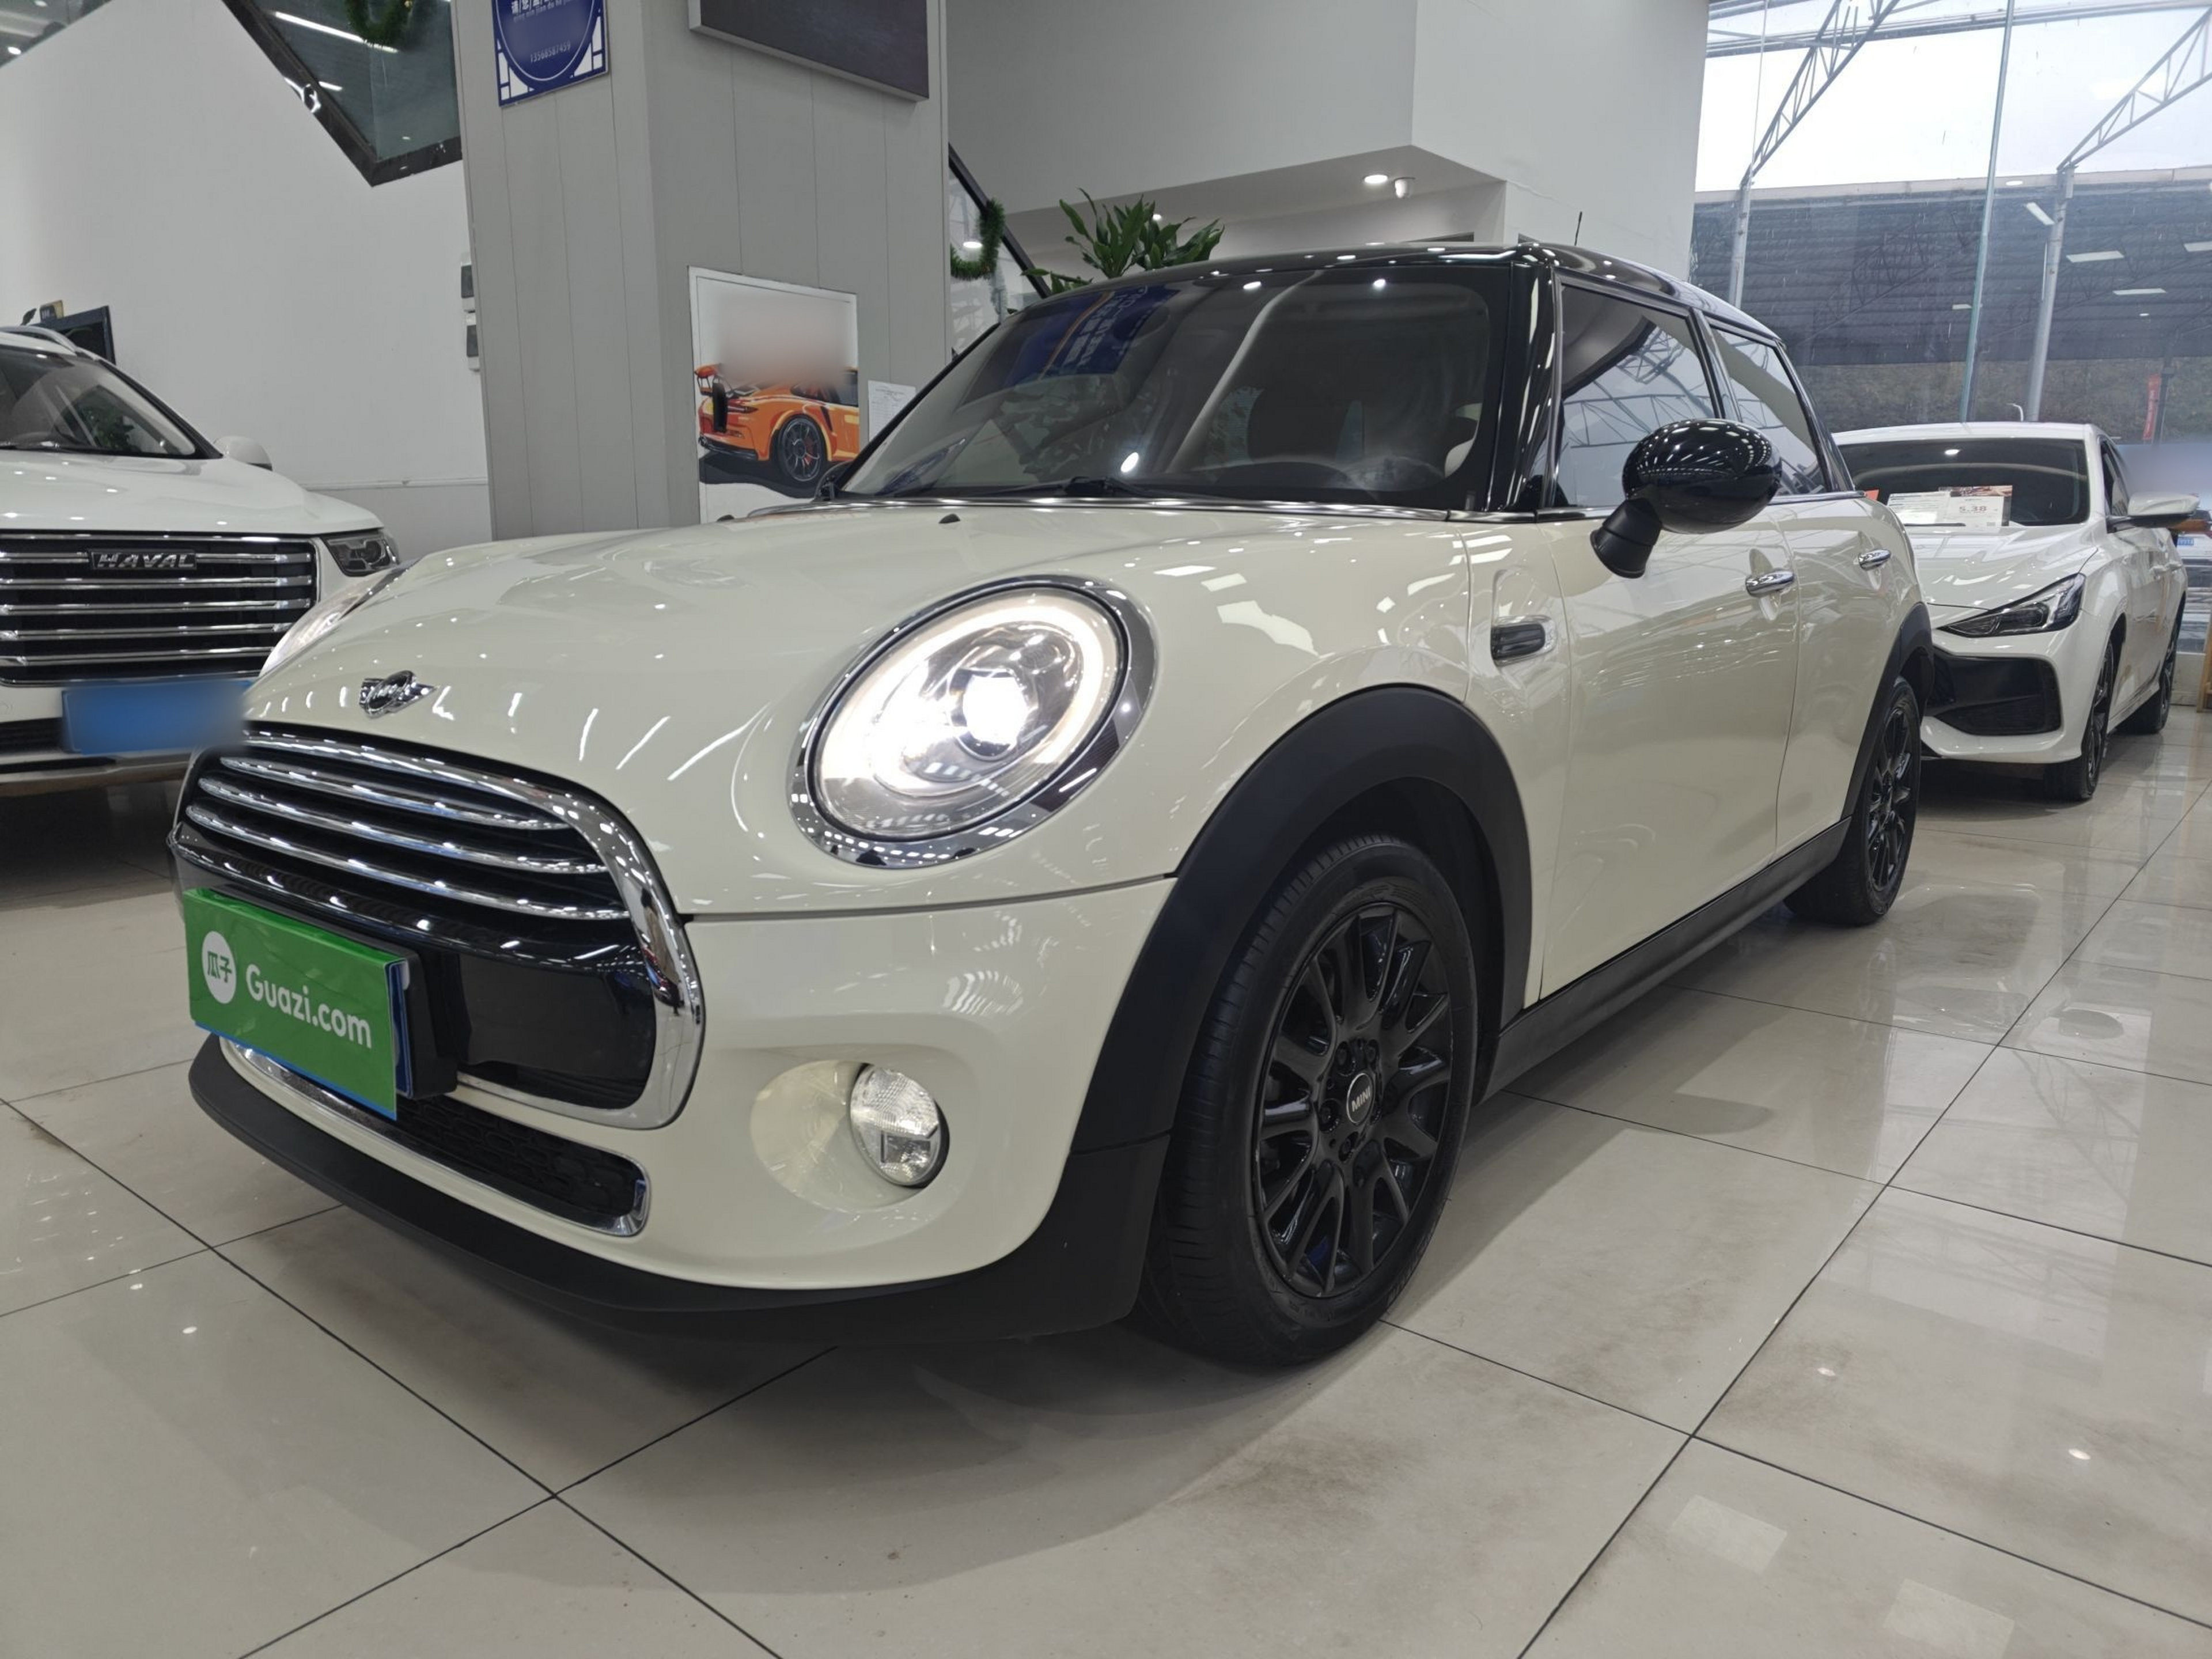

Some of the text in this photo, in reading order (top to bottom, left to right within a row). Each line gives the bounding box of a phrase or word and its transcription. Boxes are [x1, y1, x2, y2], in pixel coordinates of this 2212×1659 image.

[97, 554, 194, 568] HAVAL
[207, 950, 232, 983] 瓜子
[246, 964, 372, 1048] Guazi.com
[1351, 1085, 1371, 1112] MINI
